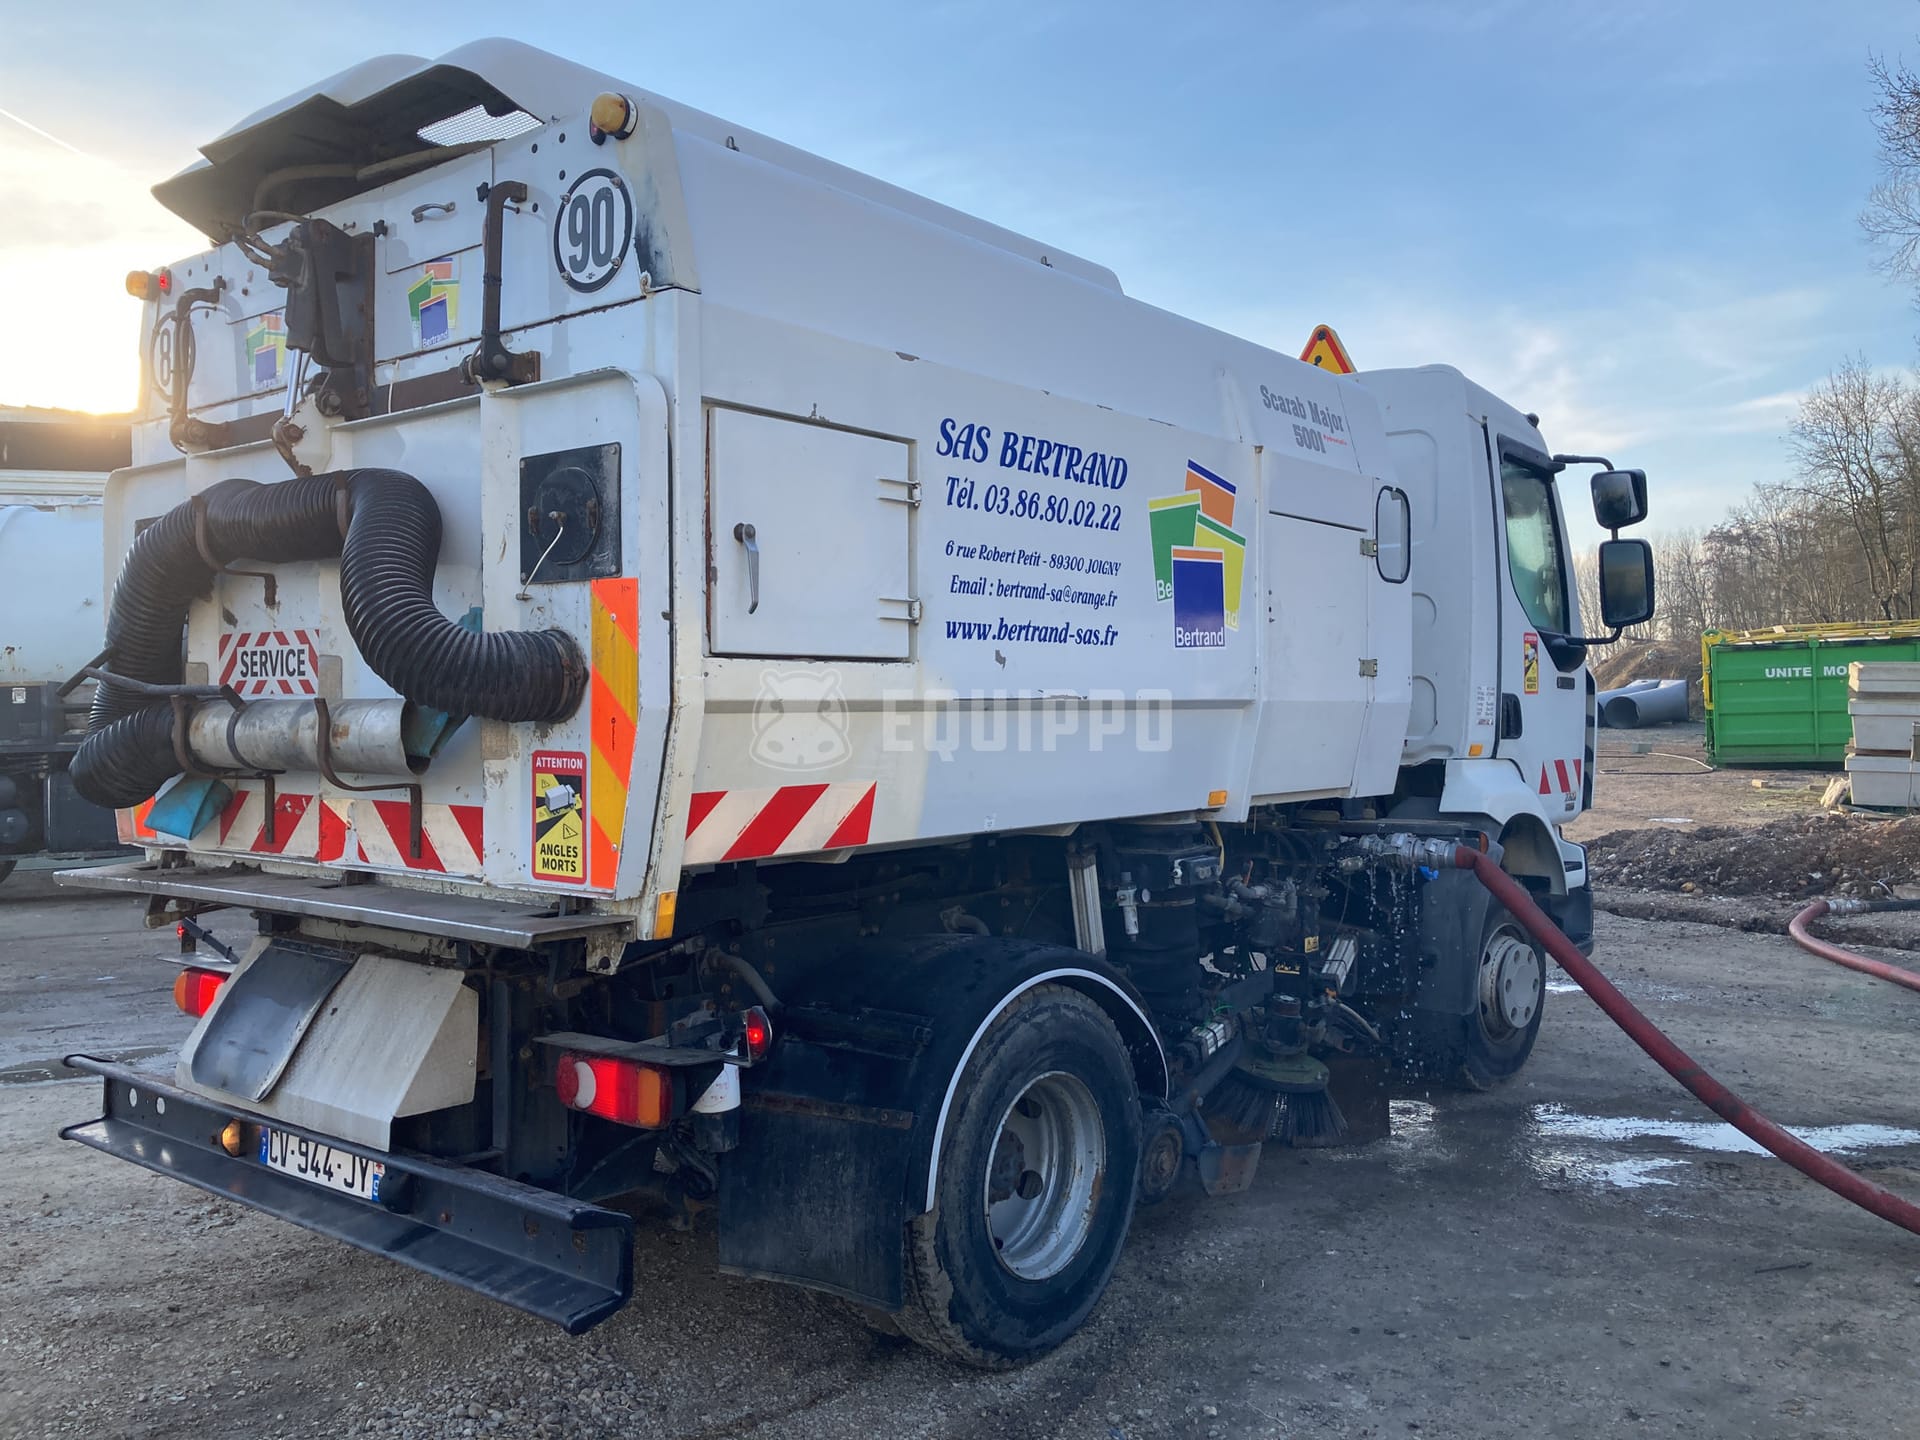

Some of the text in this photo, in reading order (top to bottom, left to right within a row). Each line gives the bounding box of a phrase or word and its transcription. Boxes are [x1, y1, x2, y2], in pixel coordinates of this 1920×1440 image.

[568, 187, 615, 273] 90
[160, 328, 172, 387] 8
[1260, 384, 1344, 434] Scarab Major
[936, 418, 1128, 490] SAS BERTRAND
[946, 476, 1122, 531] Tél. 03.86.80.02.22
[945, 540, 955, 556] 6
[956, 545, 977, 559] rue
[978, 544, 1016, 564] Robert
[1017, 549, 1041, 567] Petit
[1049, 553, 1085, 572] 89300
[1085, 558, 1122, 576] JOIGNY
[950, 574, 987, 596] Email
[997, 579, 1118, 610] bertrand-sa@orange.fr
[945, 617, 1119, 646] www.bertrand-sas.fr
[1175, 626, 1224, 647] Bertrand
[240, 648, 306, 678] SERVICE
[1765, 665, 1847, 678] UNITE MO
[536, 756, 583, 770] ATTENTION
[540, 843, 578, 858] ANGLES
[542, 858, 576, 872] MORTS
